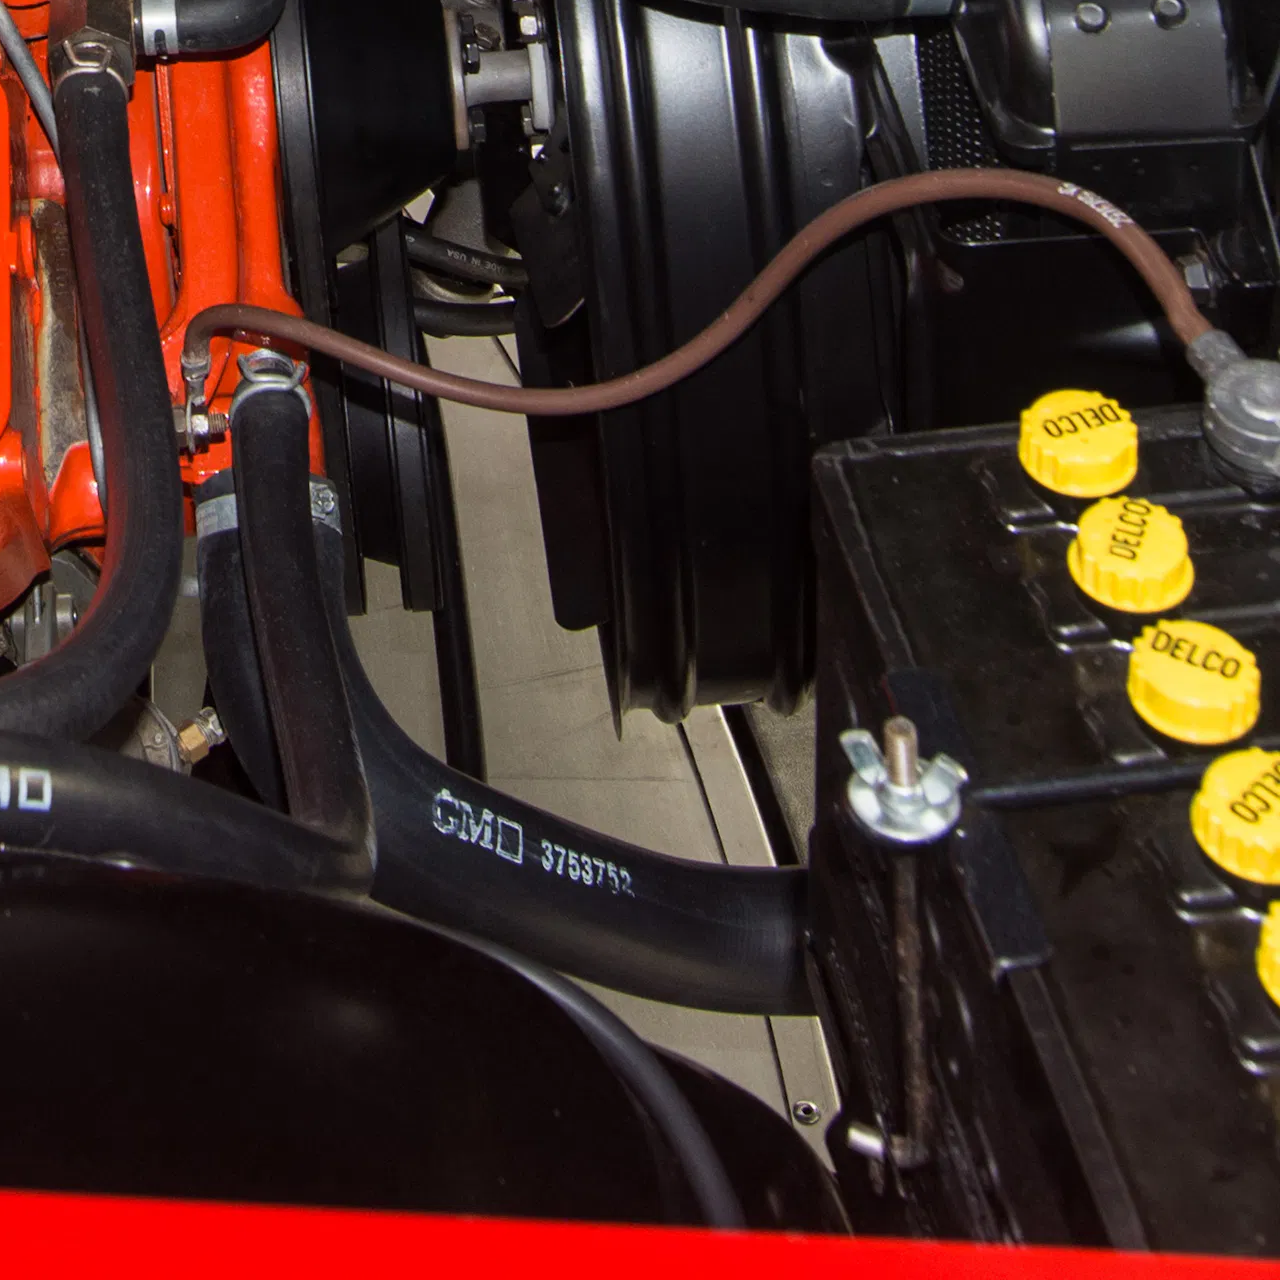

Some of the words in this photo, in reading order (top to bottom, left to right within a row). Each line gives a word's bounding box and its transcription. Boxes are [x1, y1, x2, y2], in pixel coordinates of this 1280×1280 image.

[1042, 403, 1122, 439] DELCO
[1109, 500, 1151, 560] DELCO
[1151, 629, 1242, 680] DELCO
[433, 787, 494, 851] GM
[541, 837, 636, 898] 3753752
